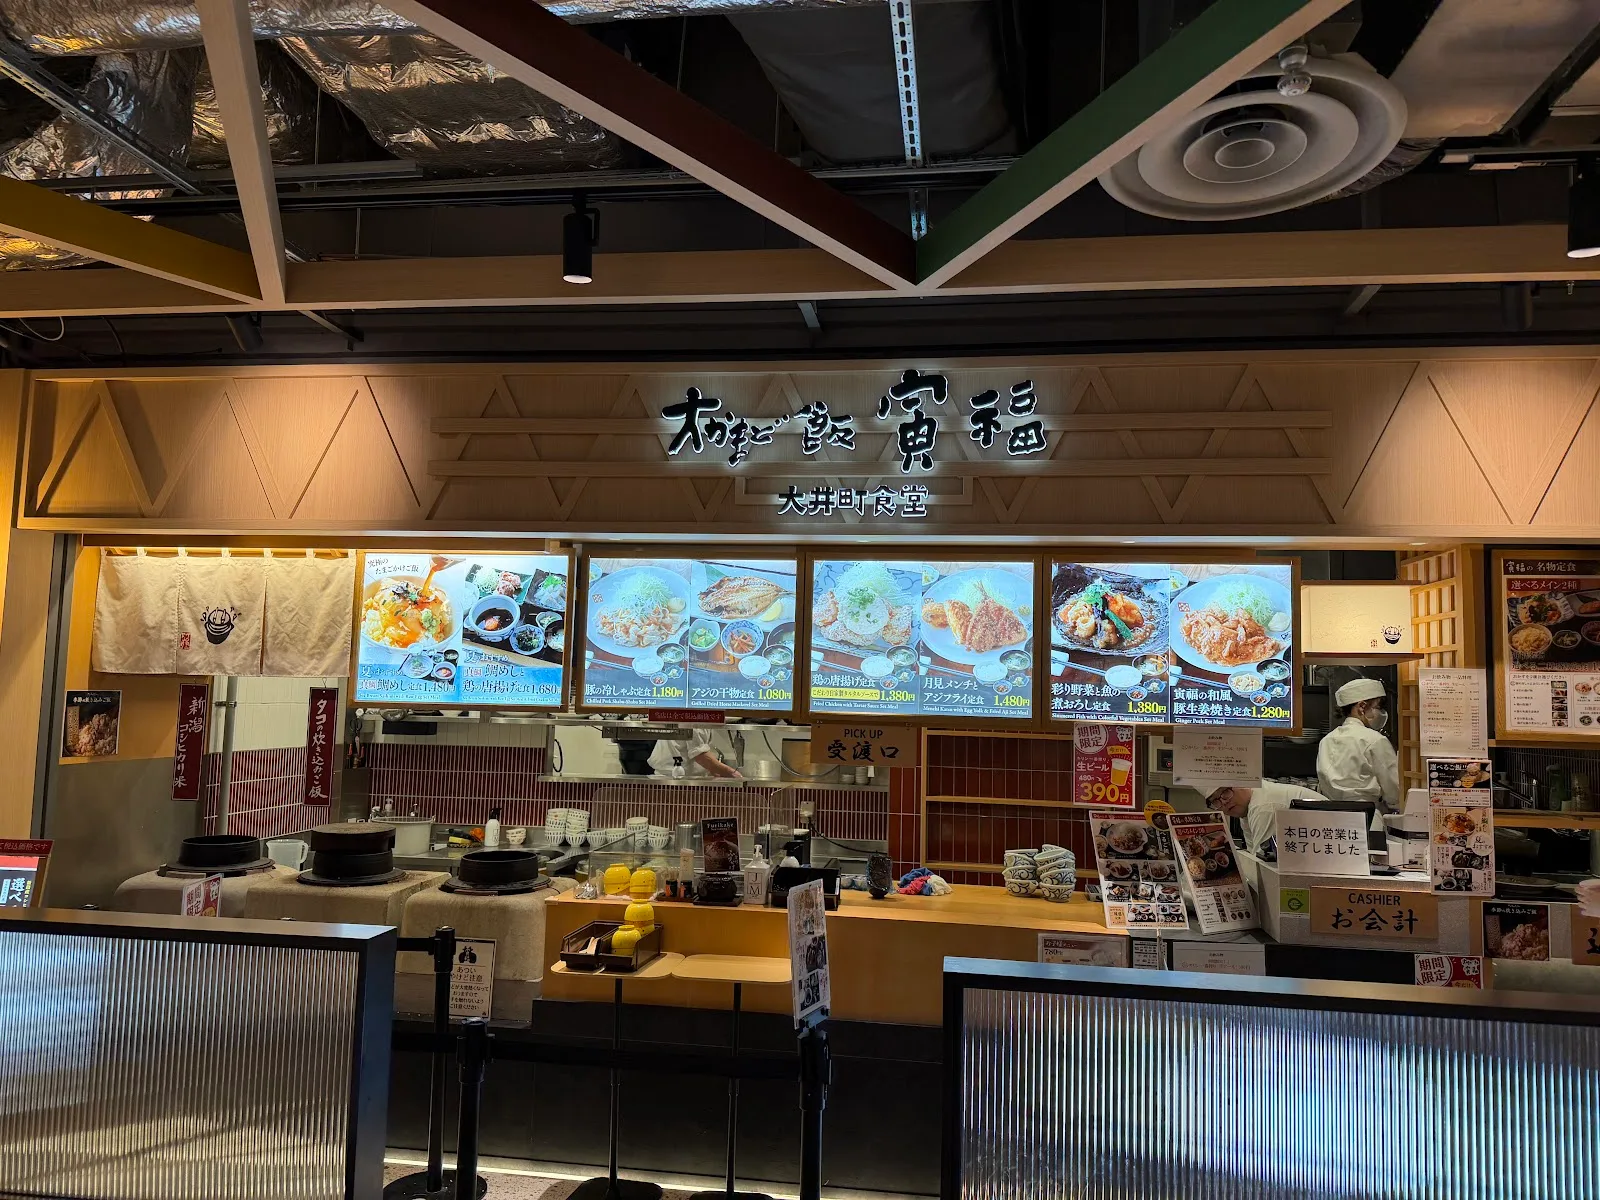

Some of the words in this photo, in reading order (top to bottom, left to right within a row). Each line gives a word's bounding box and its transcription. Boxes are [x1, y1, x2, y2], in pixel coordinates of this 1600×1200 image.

[777, 484, 929, 518] 大井町食堂
[375, 564, 419, 575] たまごかけご飯
[1511, 580, 1577, 590] 選べるメイン2種
[462, 679, 530, 693] 鶏の唐揚げ定食
[811, 674, 876, 688] 鶏の唐揚げ定食
[923, 677, 978, 690] 月見メンチと
[585, 683, 651, 697] 豚の冷しゃぶ定食
[691, 687, 755, 699] アジの干物定食
[880, 690, 915, 702] 1,380円
[1051, 683, 1121, 697] 彩り野菜と魚の
[1173, 688, 1233, 702] 寅福の和風
[923, 692, 984, 705] アジフライ定食
[993, 694, 1030, 707] 1,480円
[1051, 697, 1111, 711] 煮おろし定食
[1127, 701, 1167, 714] 1,380円
[188, 696, 206, 733] 新潟
[1173, 702, 1252, 717] 豚生姜焼き定食
[1251, 706, 1290, 718] 1,280円
[844, 728, 865, 739] PICK
[869, 729, 883, 739] UP
[1077, 724, 1101, 738] 期間
[308, 699, 329, 798] タコの炊き込みご飯
[1079, 736, 1103, 749] 限定
[173, 723, 188, 788] コシヒカリ米
[827, 739, 900, 762] 受渡口
[1076, 761, 1110, 772] 生ビール
[1080, 782, 1129, 803] 390円
[1284, 826, 1359, 841] 本日の営業は
[1284, 841, 1360, 856] 終了しました
[8, 877, 26, 907] 選べ
[186, 884, 201, 908] 期間
[749, 885, 760, 895] M
[1348, 892, 1401, 906] CASHIER
[1331, 908, 1419, 935] お会計
[1418, 956, 1444, 971] 期間
[1420, 969, 1448, 985] 限定
